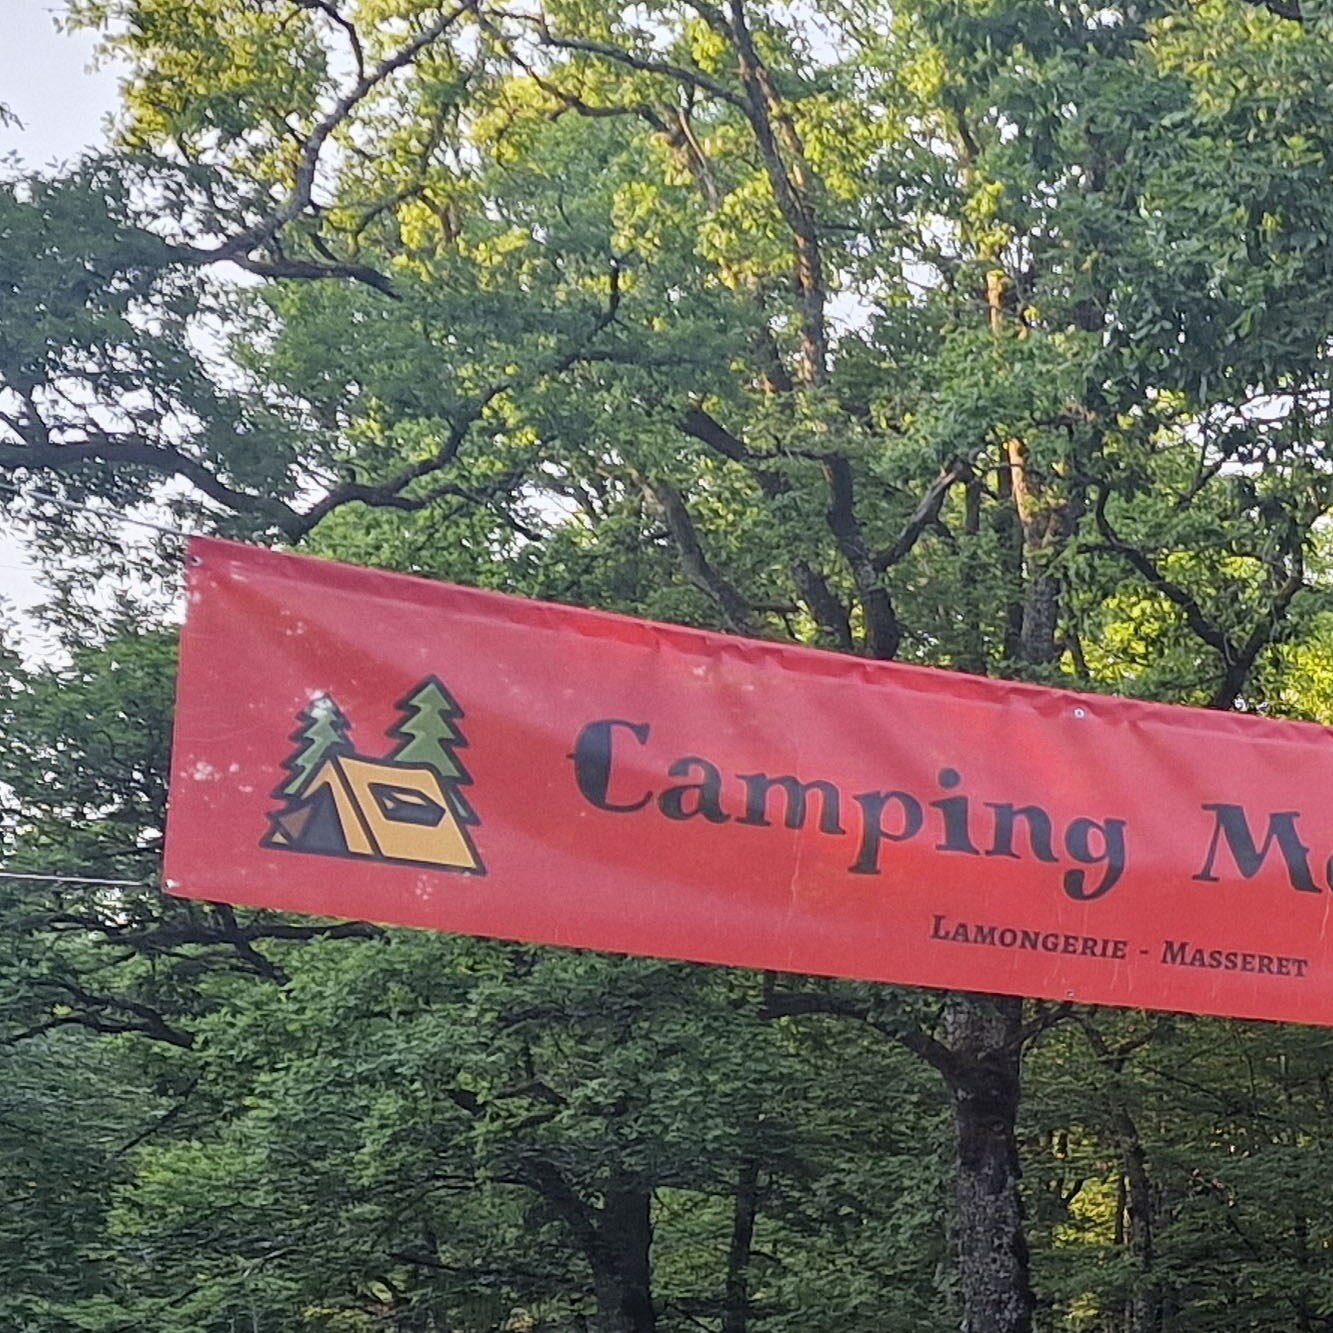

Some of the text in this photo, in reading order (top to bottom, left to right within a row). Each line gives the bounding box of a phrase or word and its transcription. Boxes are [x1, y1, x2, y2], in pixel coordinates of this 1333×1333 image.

[566, 718, 1127, 901] Camping
[930, 914, 1128, 960] LAMONGERIE
[1160, 940, 1309, 978] MASSERET
